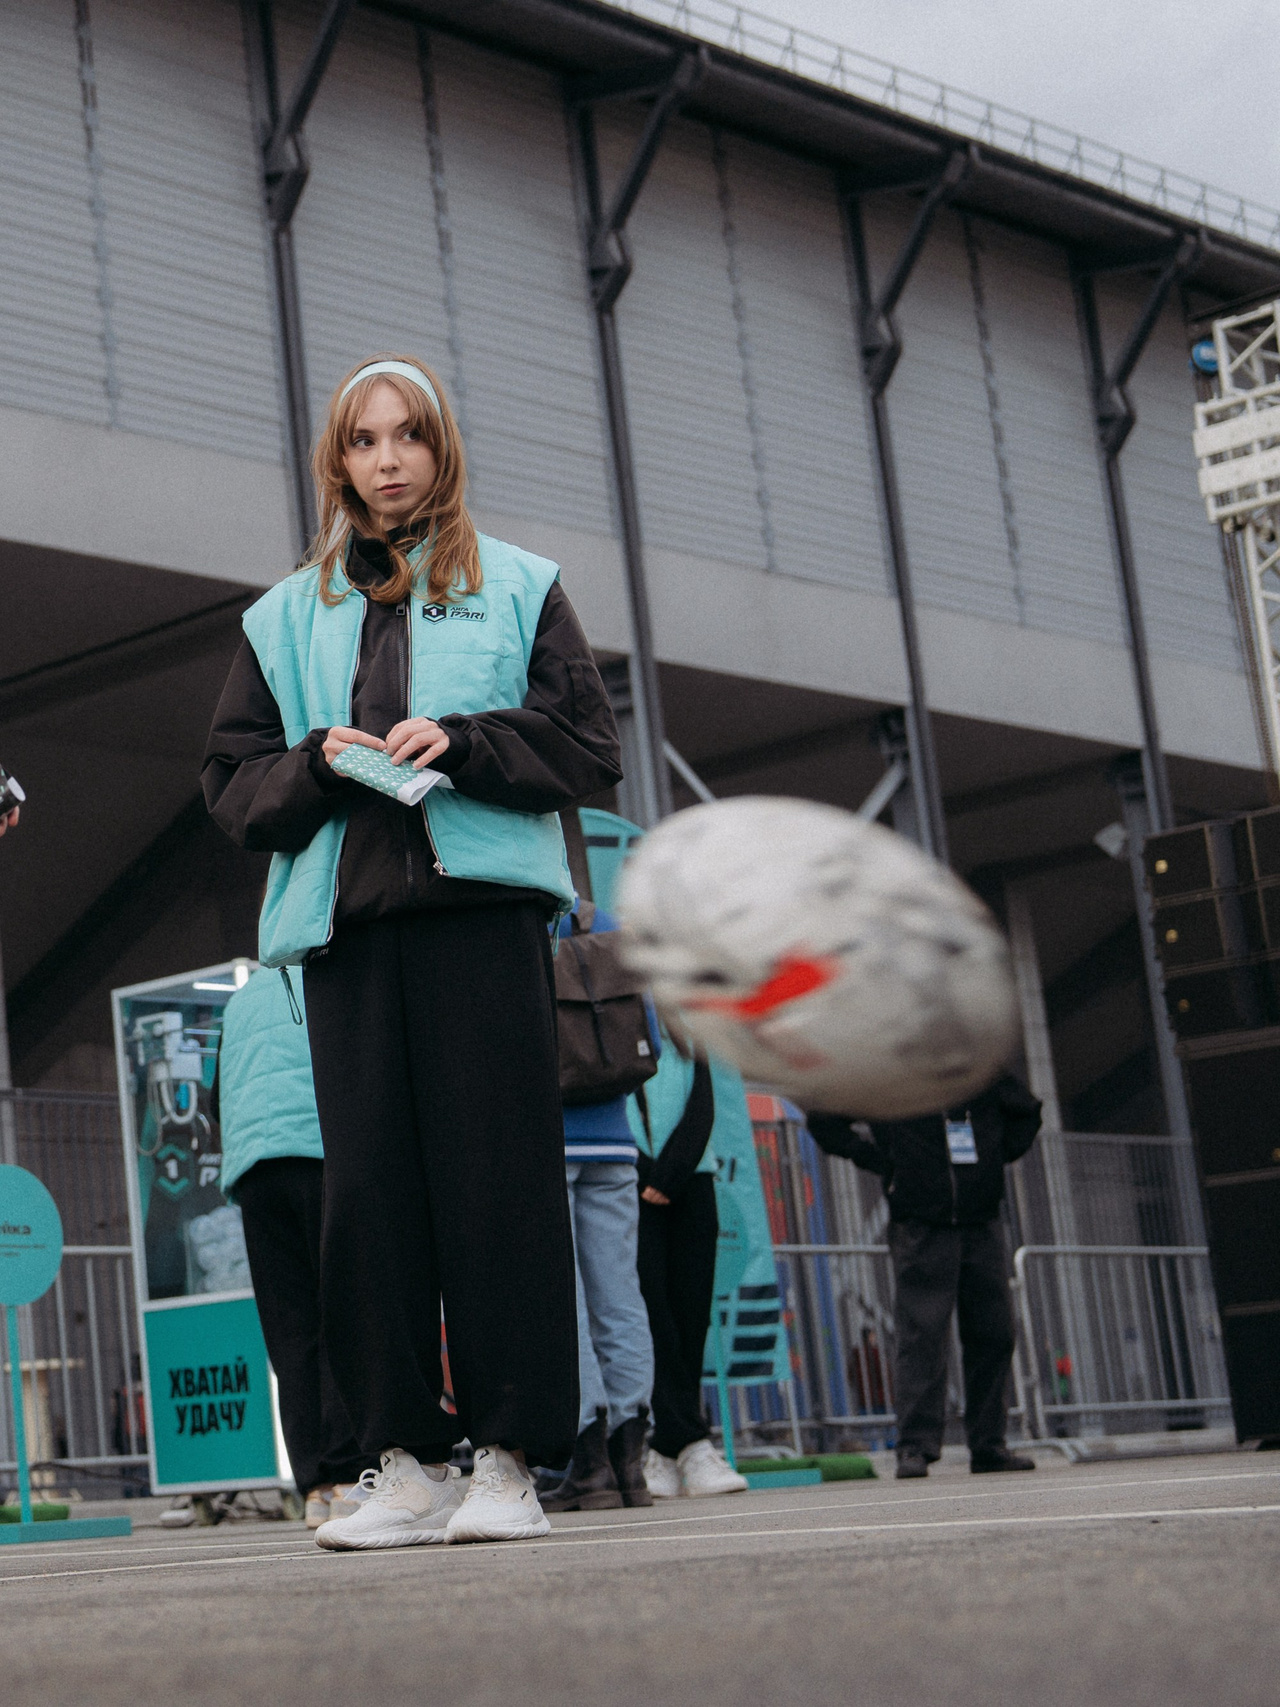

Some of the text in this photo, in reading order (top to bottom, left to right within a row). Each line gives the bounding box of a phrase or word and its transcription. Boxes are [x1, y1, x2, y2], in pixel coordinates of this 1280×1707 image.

[429, 608, 438, 616] 1
[450, 611, 485, 620] PARI
[165, 1158, 179, 1179] 1
[168, 1356, 249, 1398] ХВАТАЙ
[176, 1400, 245, 1436] УДАЧУ
